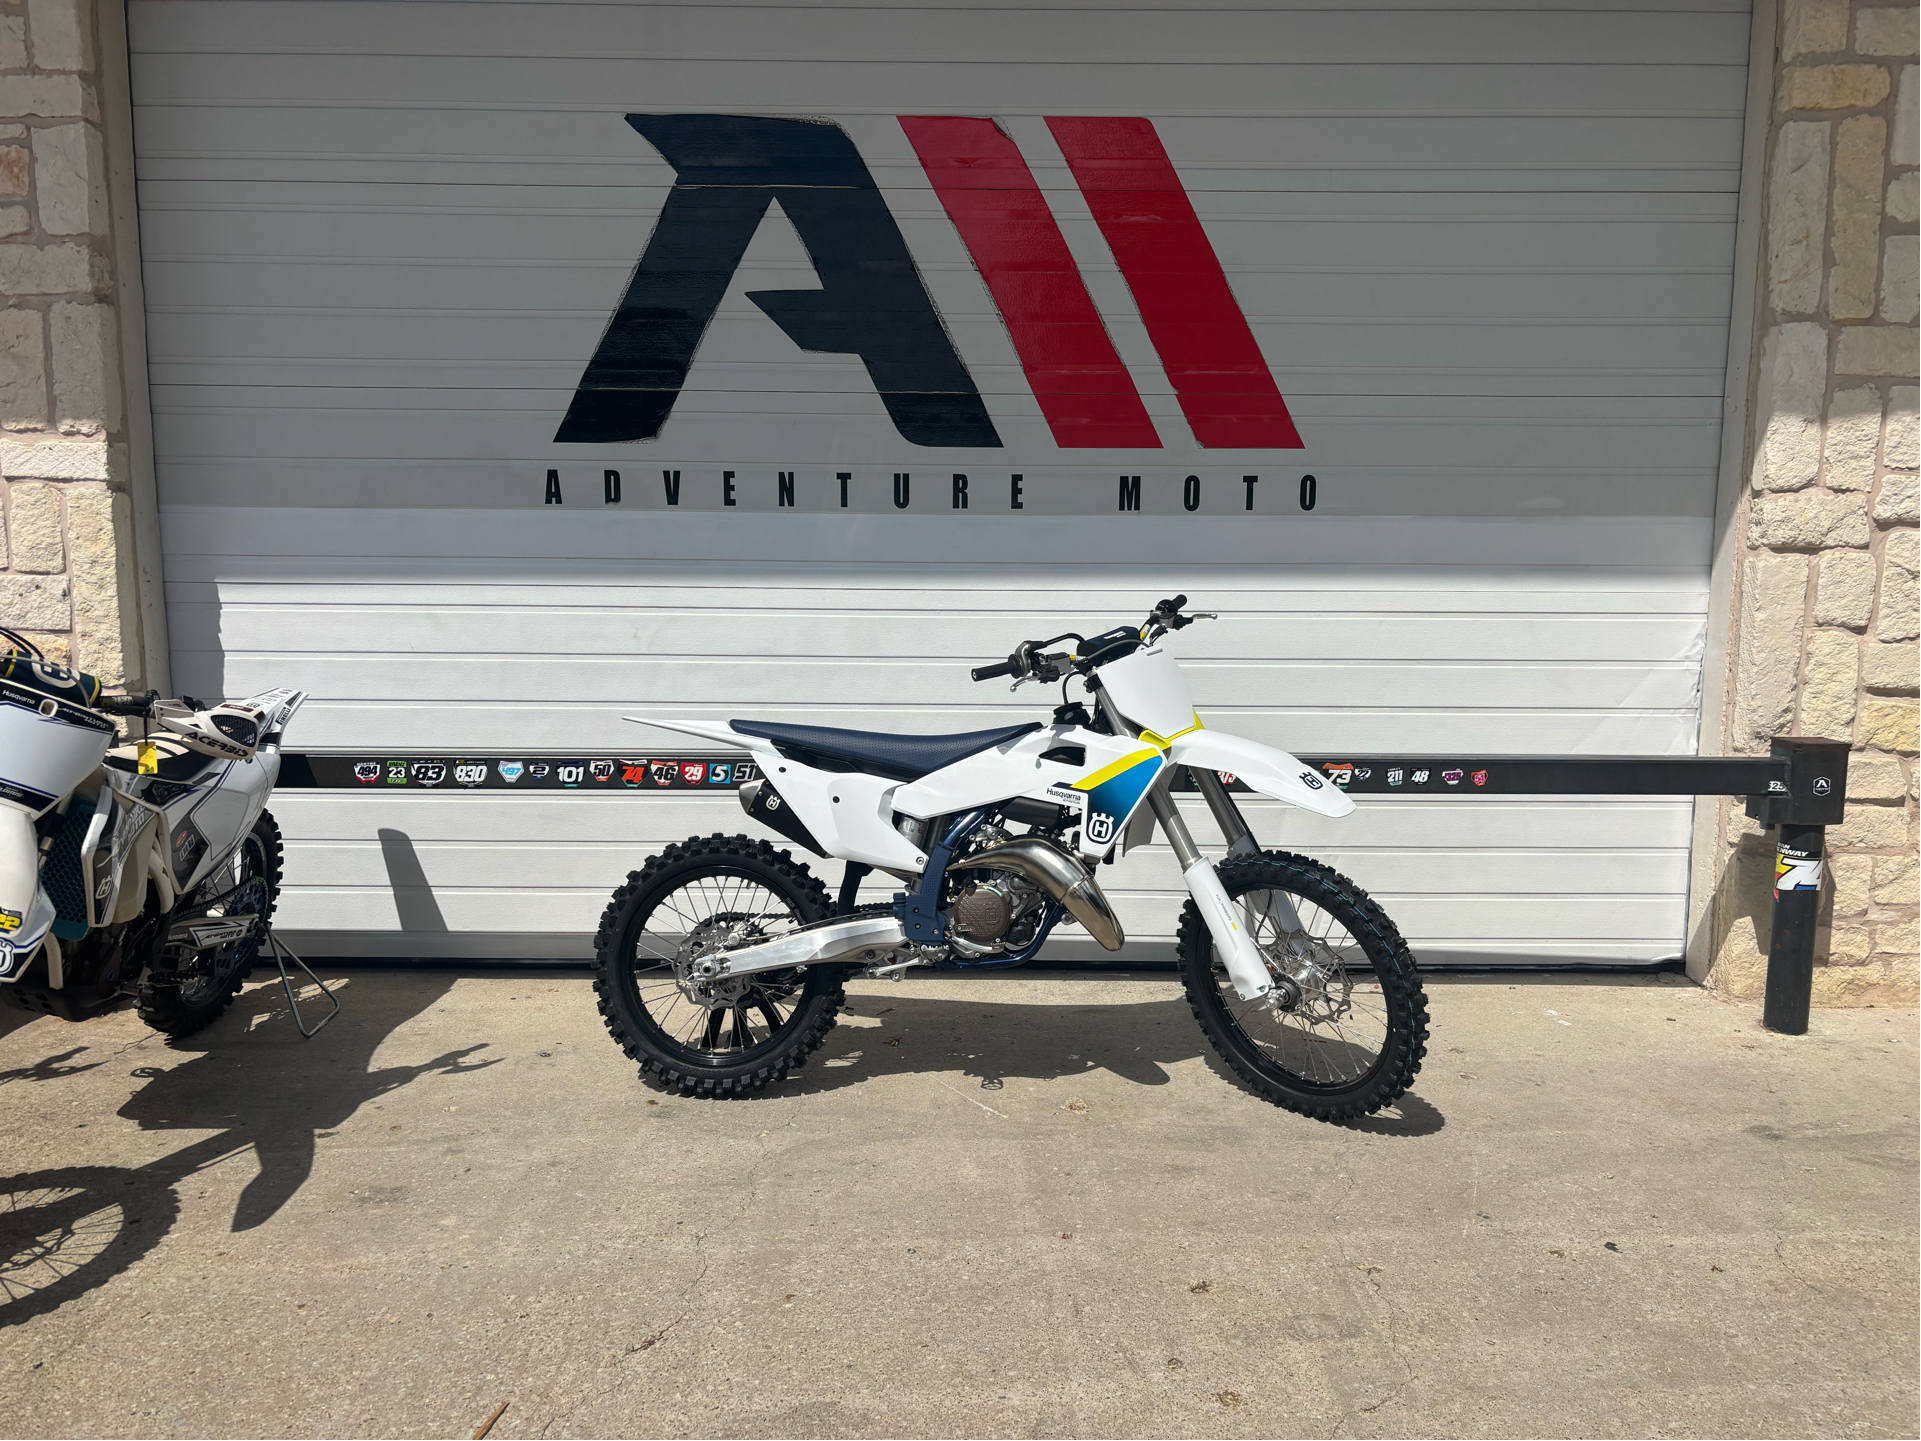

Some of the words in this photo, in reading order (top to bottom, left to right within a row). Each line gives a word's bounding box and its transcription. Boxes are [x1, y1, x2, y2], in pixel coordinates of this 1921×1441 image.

[544, 469, 1025, 509] ADVENTURE
[1118, 475, 1318, 512] MOTO
[2, 689, 36, 705] Husqvarna
[357, 765, 378, 777] 494
[388, 767, 406, 778] 23
[414, 764, 445, 782] 83
[455, 765, 488, 782] 830
[501, 766, 522, 776] 497
[557, 766, 585, 783] 101
[593, 763, 612, 777] 50
[621, 765, 645, 784] 74
[653, 766, 676, 781] 46
[684, 766, 704, 781] 29
[711, 765, 728, 781] 5
[734, 764, 757, 781] 51
[1328, 769, 1352, 784] 73
[1387, 769, 1403, 783] 211
[1411, 770, 1430, 783] 48
[1046, 788, 1081, 801] Husqvarna
